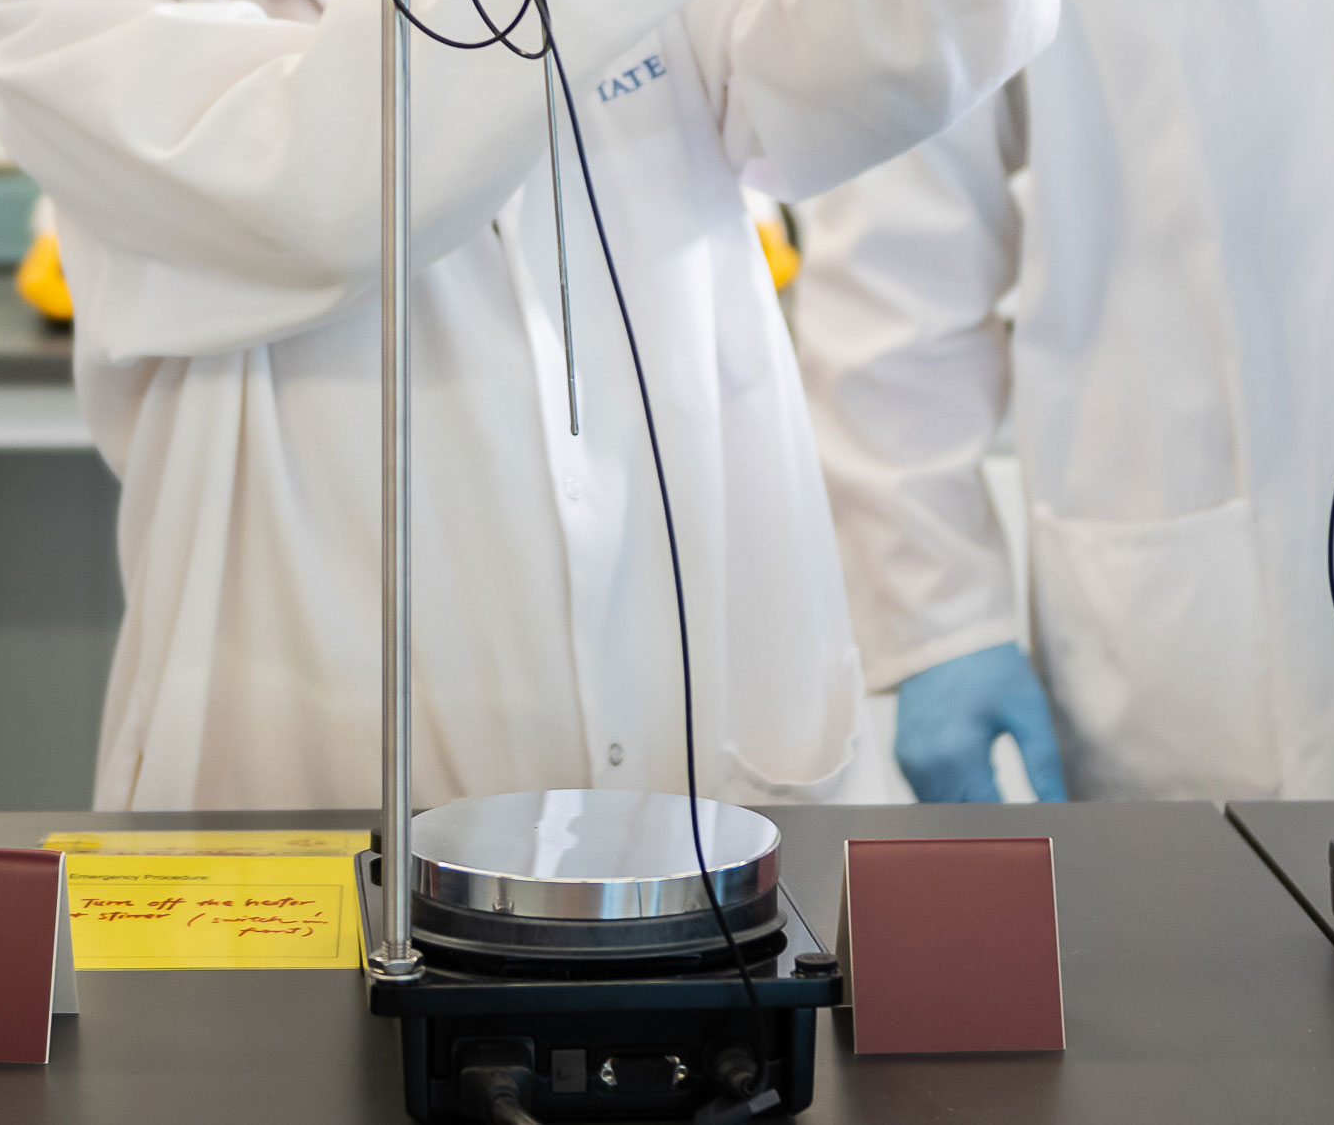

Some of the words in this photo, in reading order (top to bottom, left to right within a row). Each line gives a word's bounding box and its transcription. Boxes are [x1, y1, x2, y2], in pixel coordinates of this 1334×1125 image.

[69, 873, 140, 881] Emergency
[81, 898, 135, 909] Turn
[147, 897, 186, 911] off
[197, 898, 234, 907] the
[244, 897, 316, 908] heater
